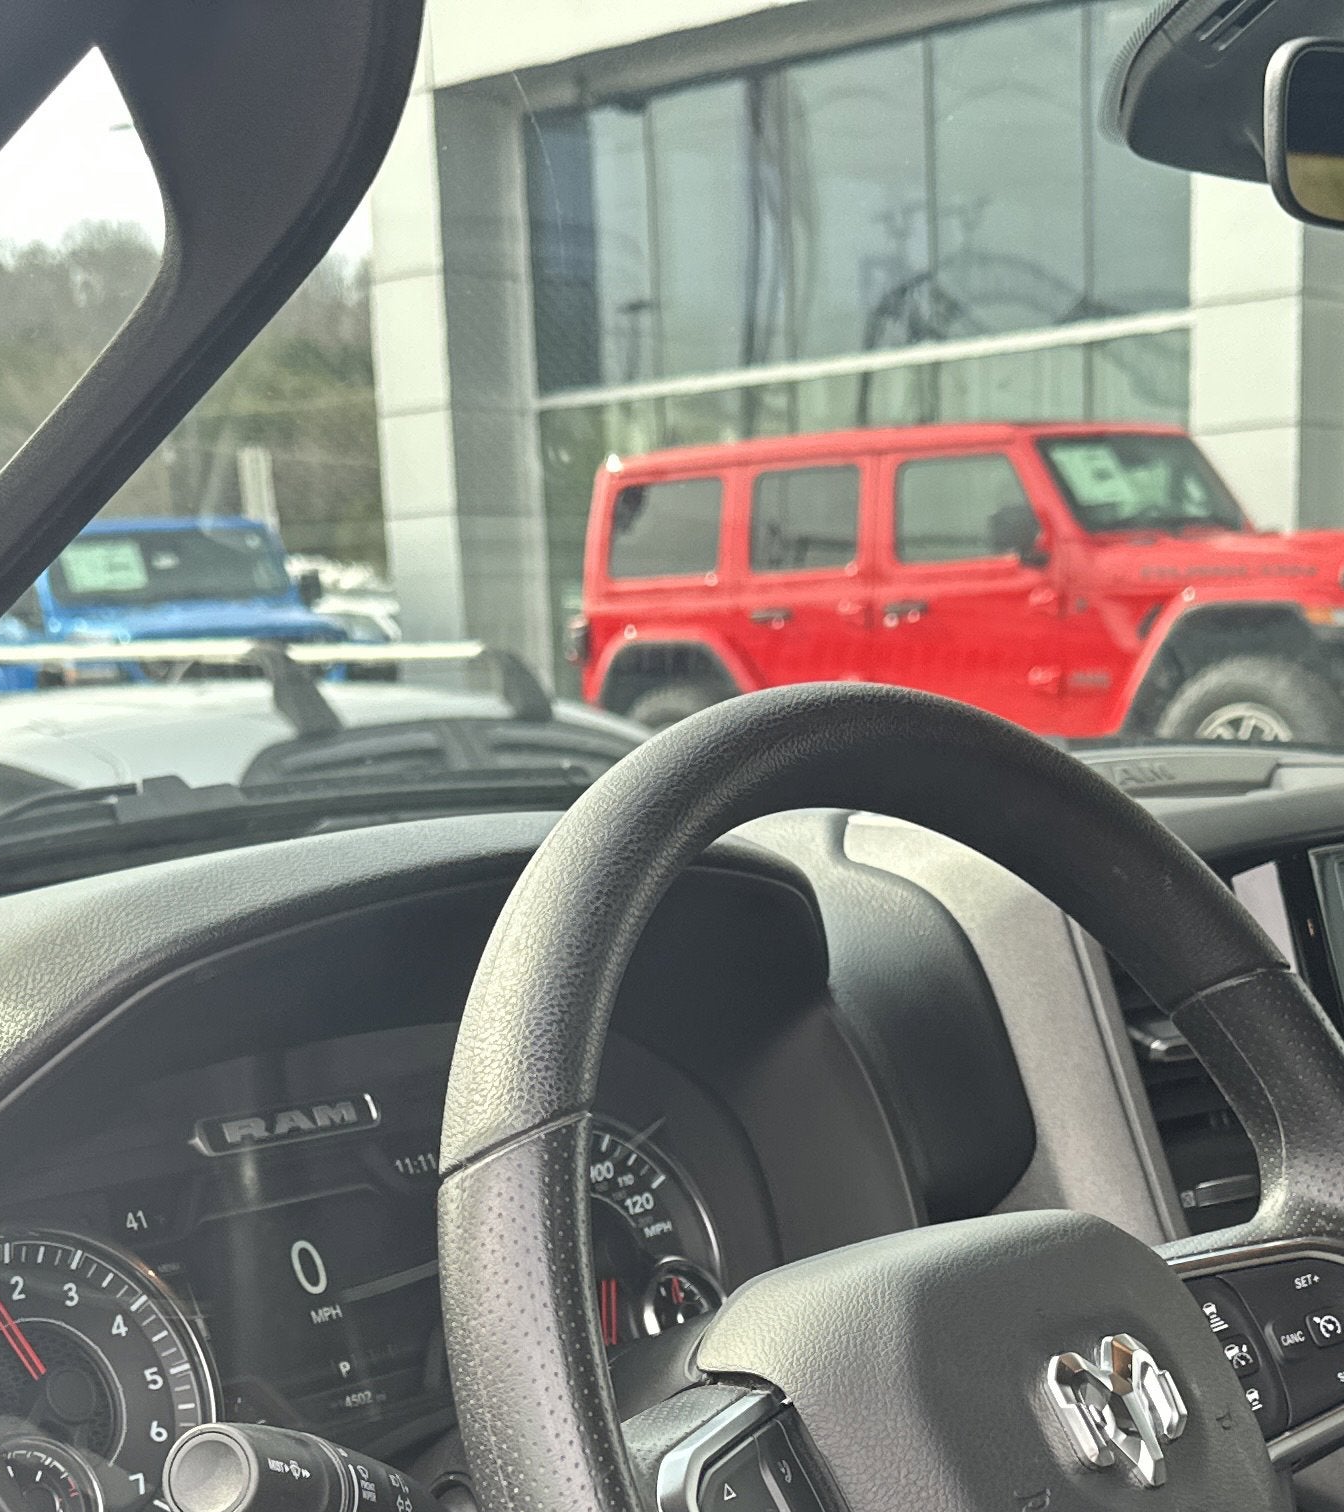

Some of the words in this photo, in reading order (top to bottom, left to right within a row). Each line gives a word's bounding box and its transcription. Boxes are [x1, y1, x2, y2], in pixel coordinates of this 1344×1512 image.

[222, 1101, 358, 1144] RAM
[395, 1153, 437, 1175] 11:11
[625, 1192, 654, 1215] 120
[126, 1210, 148, 1230] 41
[643, 1221, 672, 1238] MPH
[291, 1240, 328, 1294] 0
[10, 1276, 26, 1300] 2
[63, 1283, 80, 1307] 3
[310, 1304, 343, 1324] MPH
[111, 1314, 128, 1337] 4
[1280, 1331, 1306, 1346] CANC
[143, 1367, 164, 1390] 5
[339, 1361, 351, 1377] P
[149, 1421, 168, 1442] 6
[129, 1473, 145, 1495] 7
